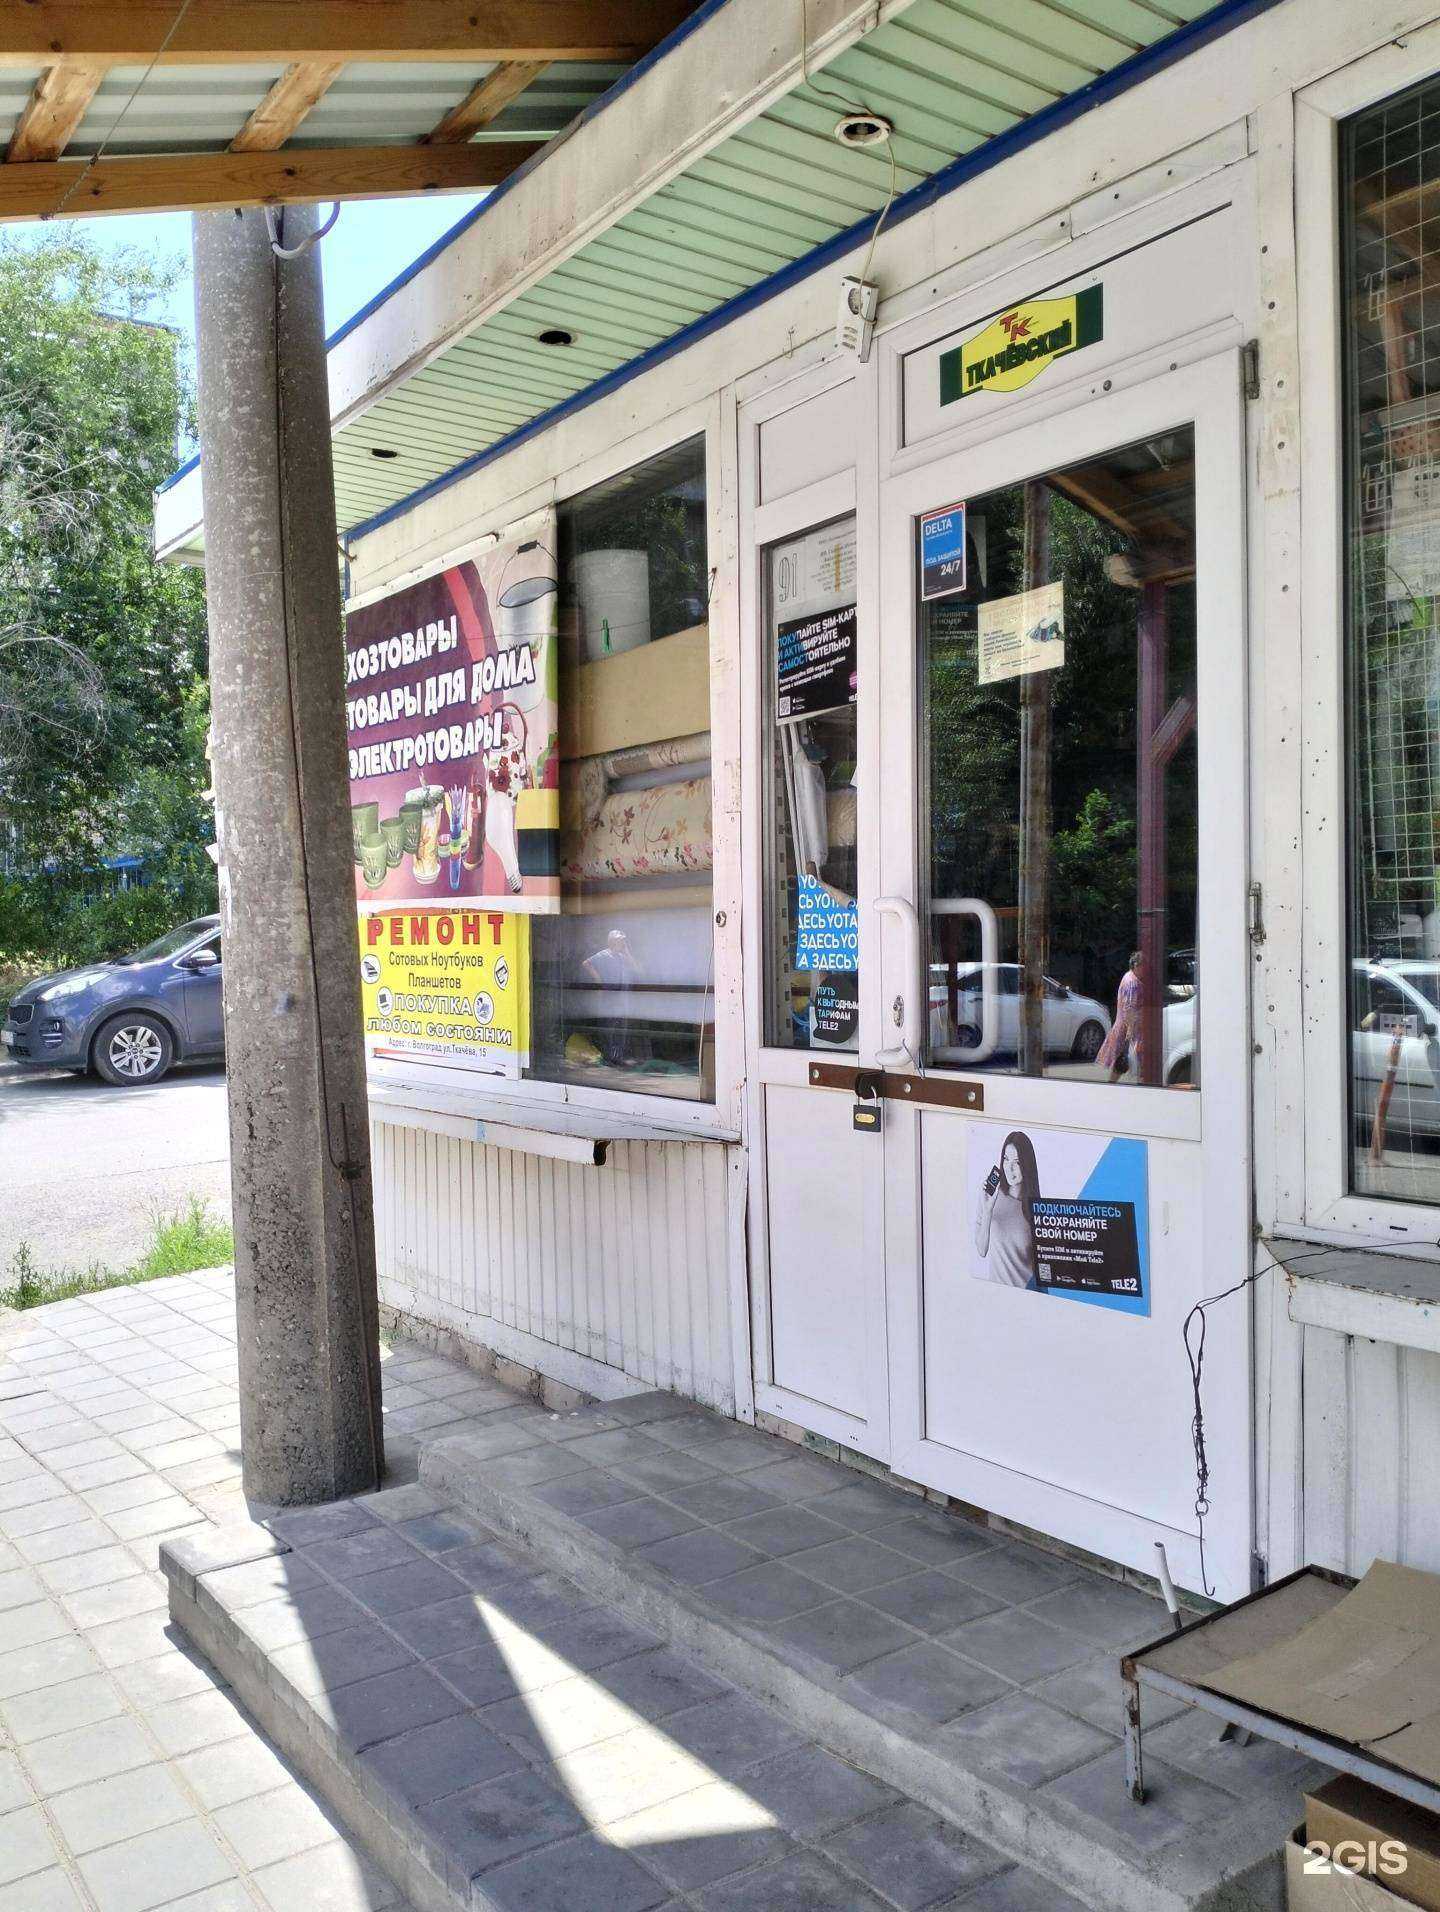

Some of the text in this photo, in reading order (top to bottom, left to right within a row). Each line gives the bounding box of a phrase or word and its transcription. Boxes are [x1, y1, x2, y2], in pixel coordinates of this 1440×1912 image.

[925, 517, 952, 536] DELTA
[940, 560, 961, 576] 24/7
[347, 615, 458, 683] ХОЗТОВАРЫ
[778, 635, 851, 673] САМОСТОЯТЕЛЬНО
[346, 645, 536, 731] ТОВАРЫ ДЛЯ ДОМА
[348, 711, 503, 780] ЭЛЕКТРОТОВАРЫ
[367, 914, 504, 946] РЕМОНТ
[800, 933, 858, 951] ЗДЕСЬ YO
[389, 951, 484, 972] Сотовых Ноутбуков
[812, 953, 852, 971] ЗДЕСЬ
[408, 972, 461, 989] Планшетов
[816, 986, 836, 997] ПУТЬ
[394, 992, 474, 1017] ПОКУПКА
[818, 1011, 851, 1022] ТАРИФАМ
[819, 1020, 840, 1031] TELE2
[1033, 1202, 1122, 1218] ПОДКЛЮЧАЙТЕСЬ
[1034, 1215, 1108, 1230] И СОХРАНЯЙТЕ
[1035, 1227, 1098, 1242] СВОЙ НОМЕР
[1111, 1278, 1138, 1291] TELE2
